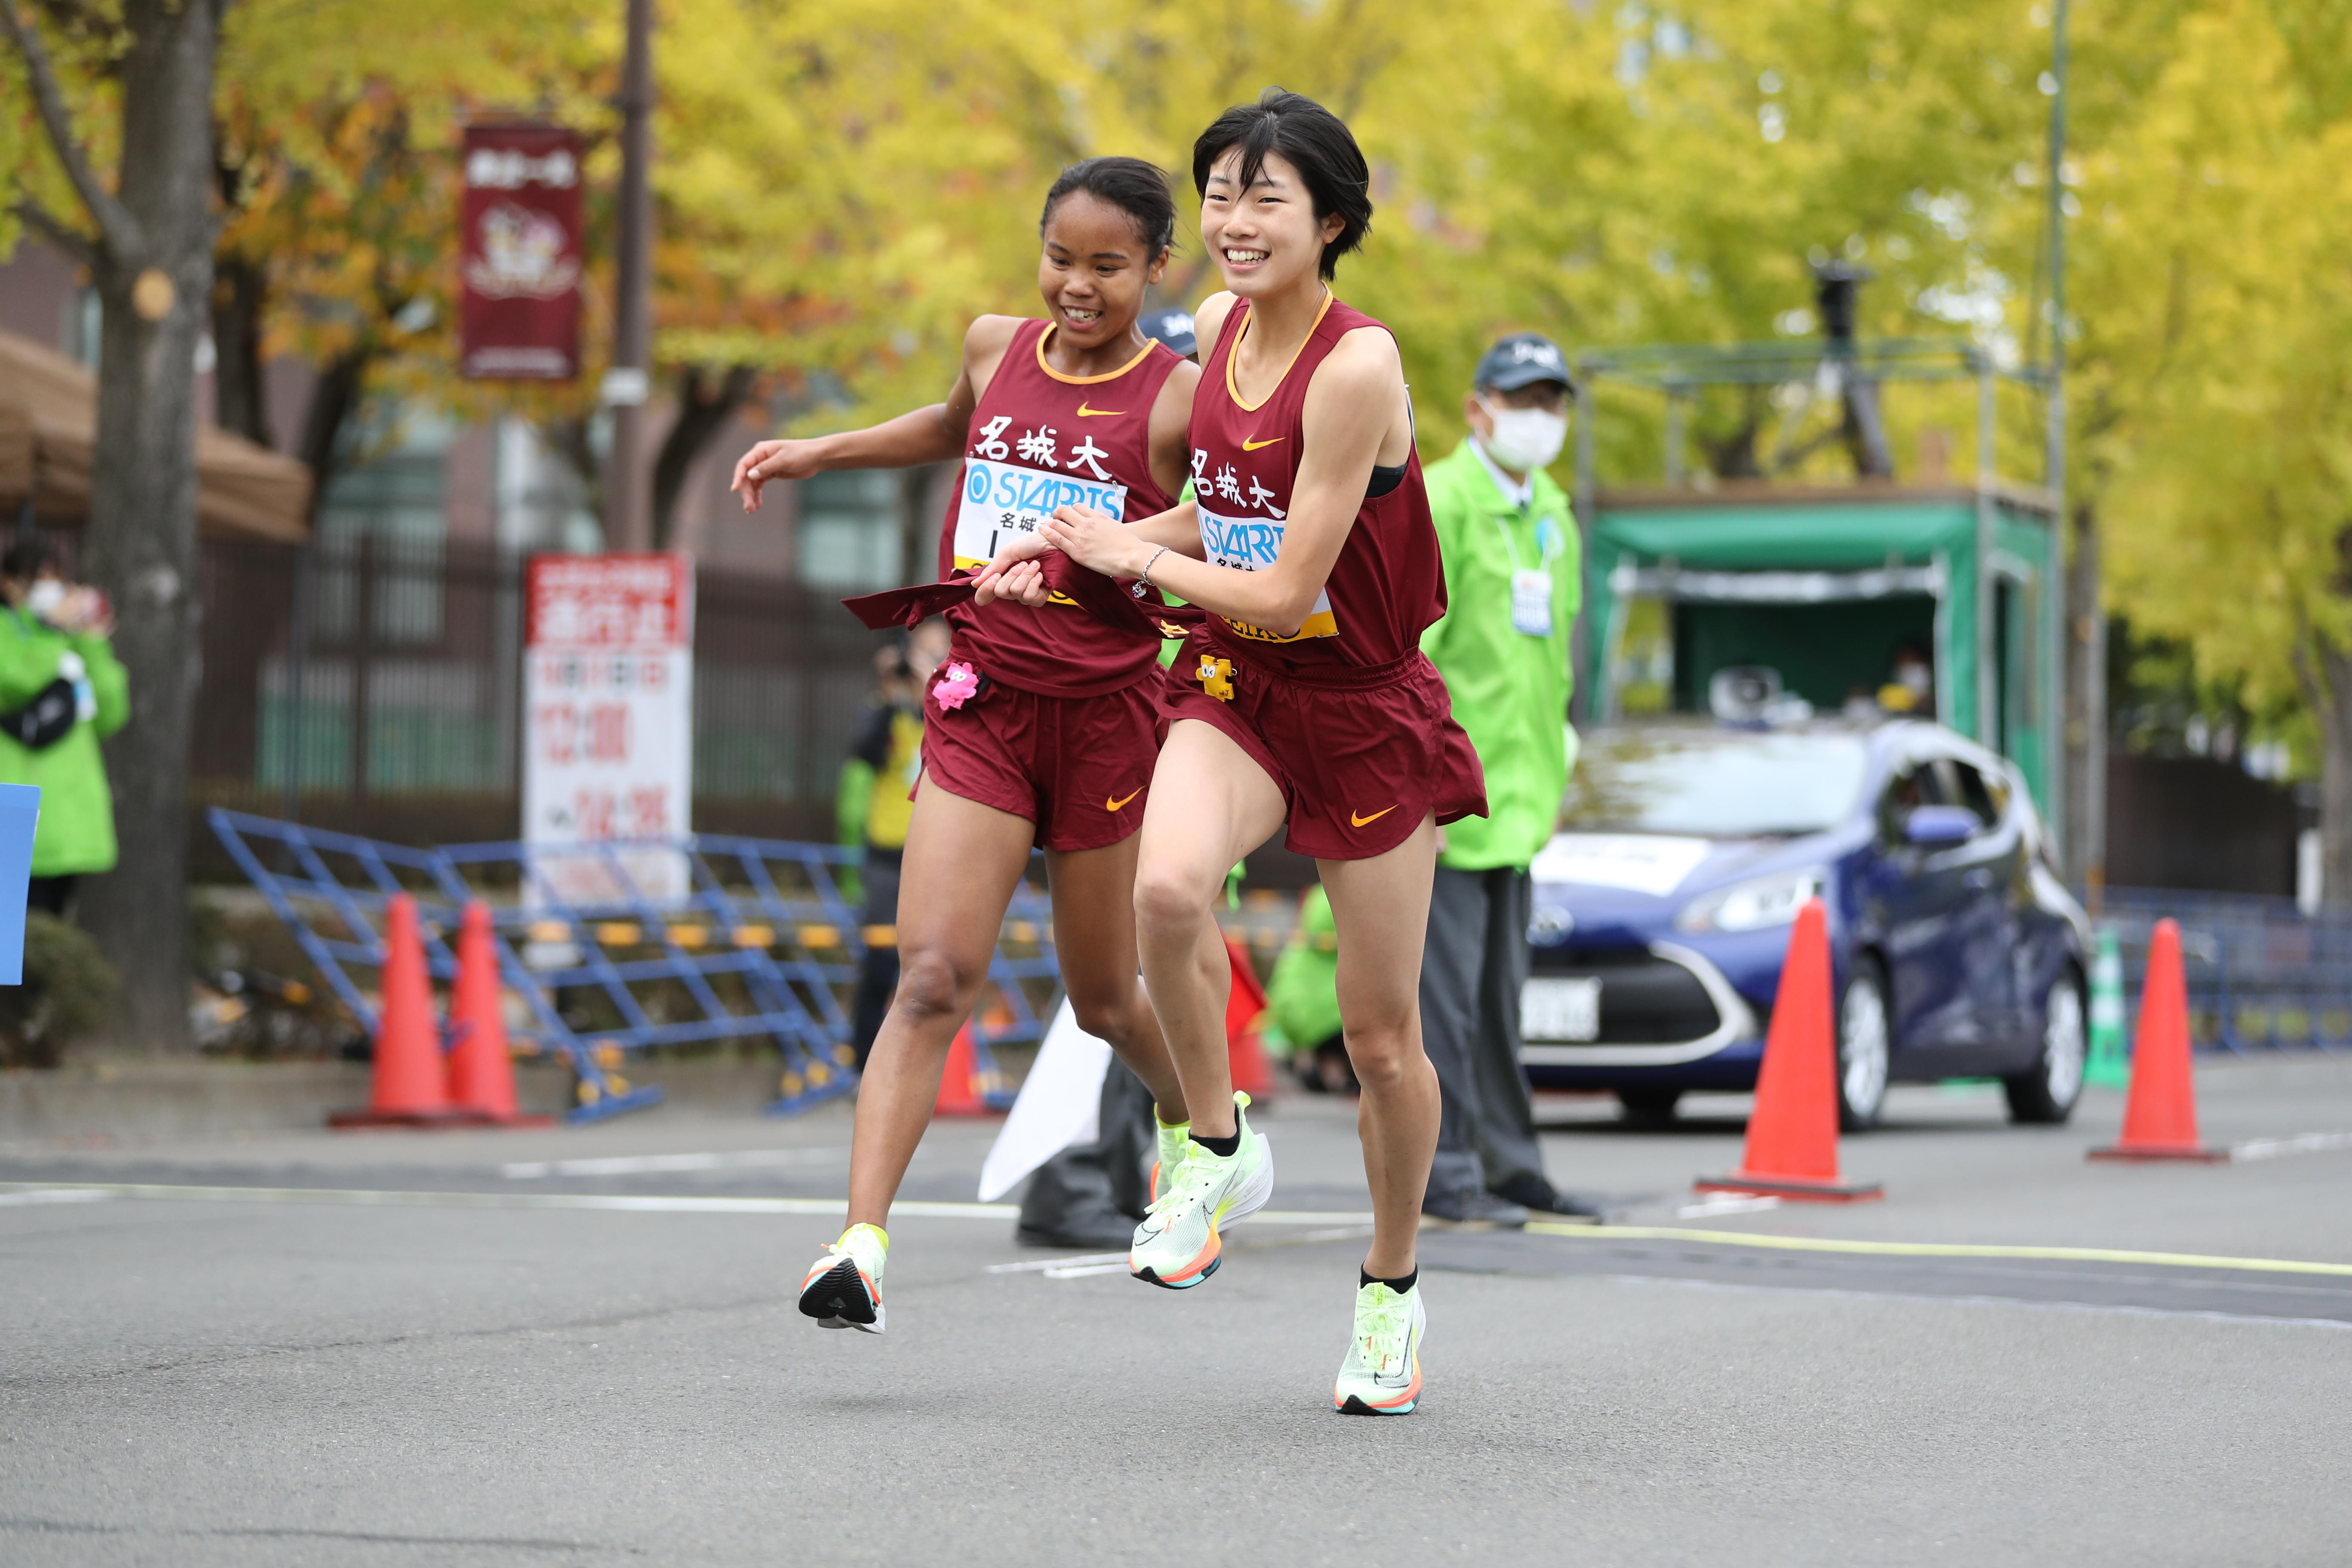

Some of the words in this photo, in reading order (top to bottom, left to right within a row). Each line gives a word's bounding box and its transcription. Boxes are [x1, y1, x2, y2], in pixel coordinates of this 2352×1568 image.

[974, 415, 1112, 481] 名城大
[994, 472, 1119, 523] STARTS
[1191, 448, 1286, 519] 名城大
[1000, 512, 1044, 532] 名城
